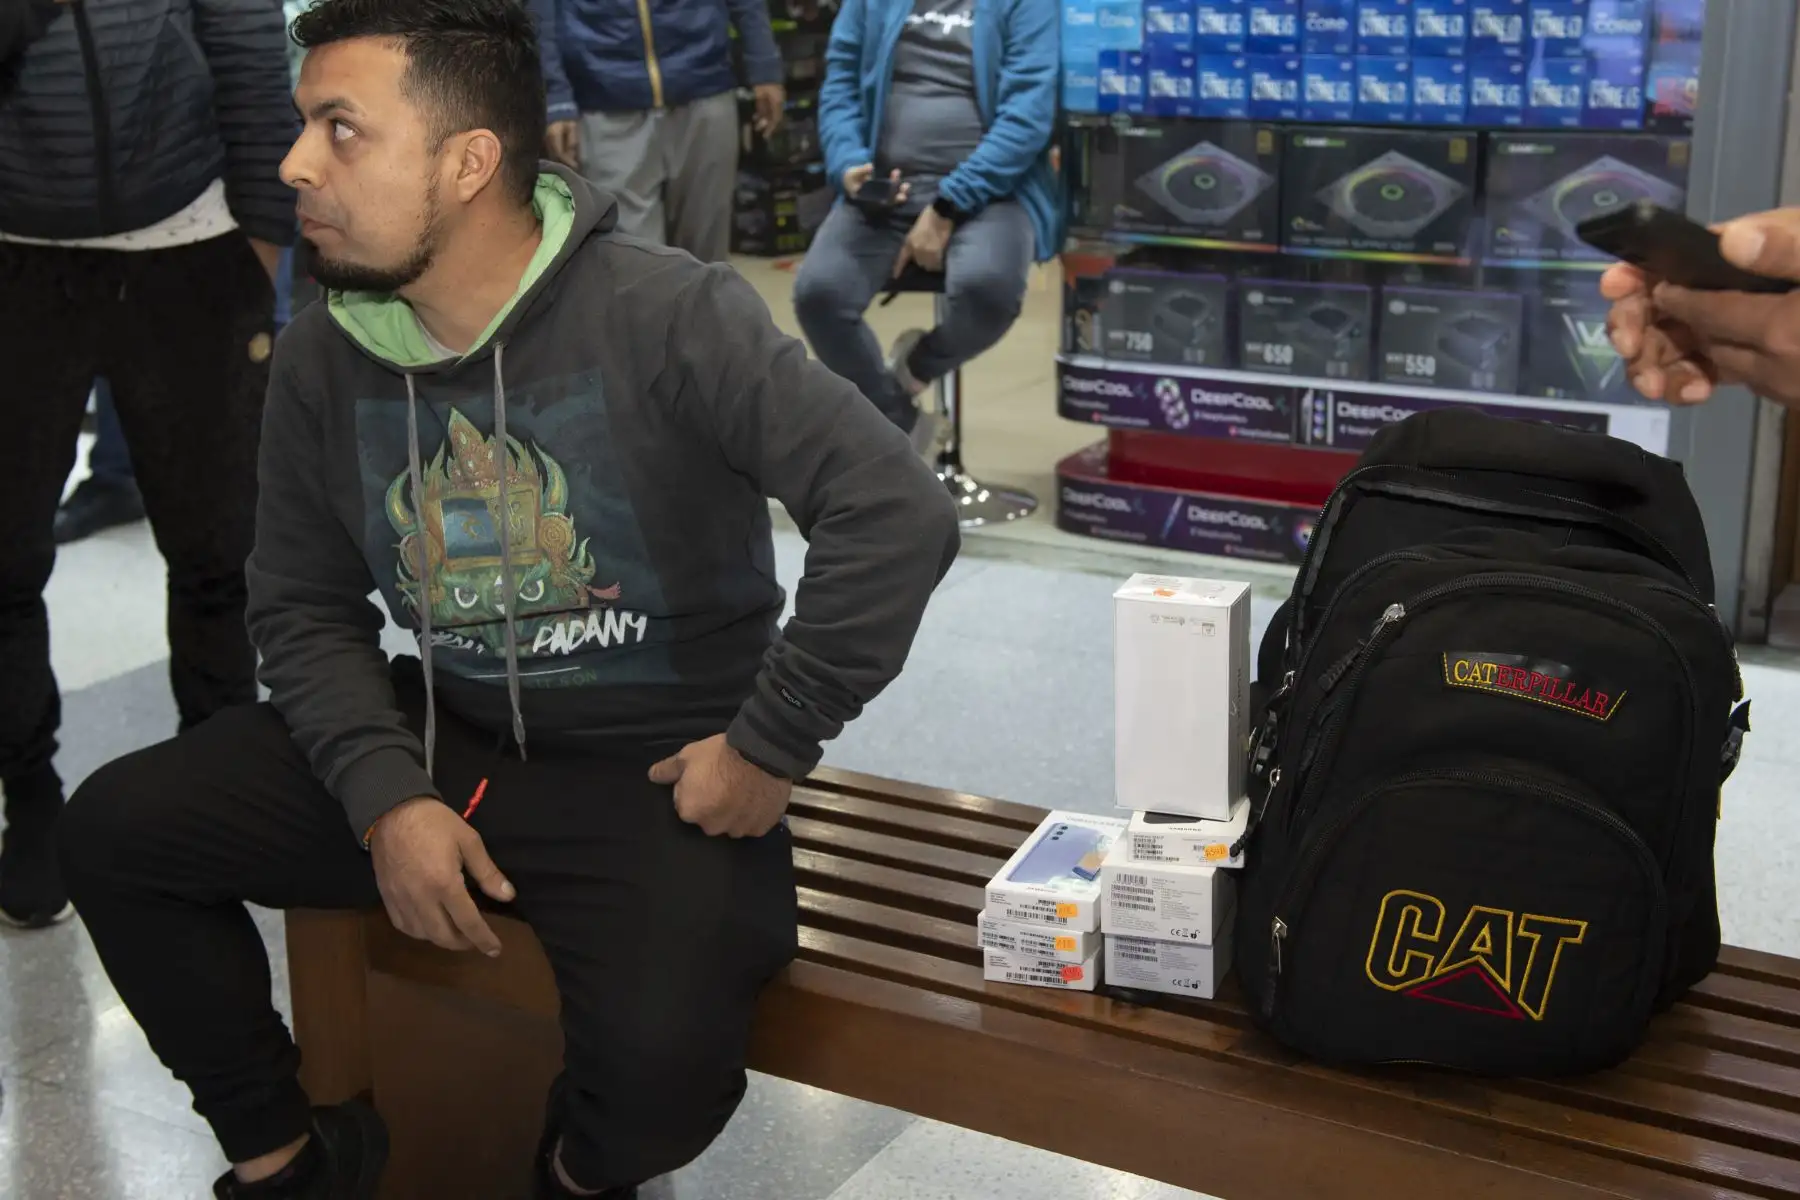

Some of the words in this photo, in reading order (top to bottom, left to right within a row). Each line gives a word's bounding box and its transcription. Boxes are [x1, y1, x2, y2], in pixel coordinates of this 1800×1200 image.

[1127, 331, 1153, 351] 750
[1263, 343, 1293, 365] 650
[1405, 353, 1435, 377] 550
[1453, 658, 1610, 716] CATERPILLAR
[1365, 889, 1589, 1021] CAT
